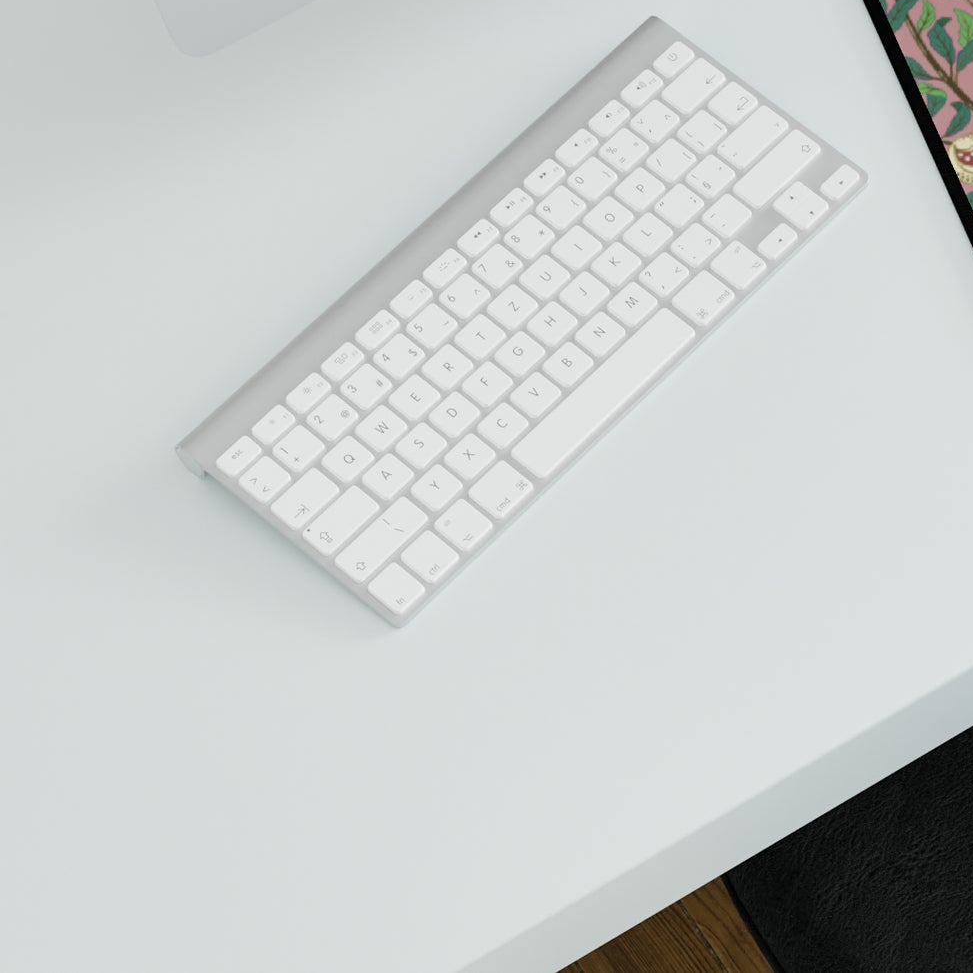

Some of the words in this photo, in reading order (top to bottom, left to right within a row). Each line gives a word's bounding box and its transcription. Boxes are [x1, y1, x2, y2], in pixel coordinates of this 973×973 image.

[574, 176, 585, 185] 0
[635, 183, 645, 194] P
[542, 205, 552, 214] 9
[604, 212, 616, 223] O
[510, 234, 521, 244] 8
[640, 229, 653, 238] L
[607, 255, 622, 267] K
[477, 263, 487, 273] 7
[538, 270, 553, 282] U
[578, 286, 588, 297] J
[446, 293, 457, 303] 6
[624, 296, 640, 309] M
[507, 300, 521, 313] Z
[543, 315, 557, 328] H
[413, 323, 424, 333] 5
[592, 326, 607, 339] N
[474, 330, 486, 341] T
[407, 348, 418, 358] $
[512, 346, 524, 357] G
[381, 353, 391, 362] 4
[560, 357, 573, 368] B
[441, 362, 455, 372] R
[479, 376, 489, 387] F
[346, 384, 358, 394] 3
[527, 387, 540, 397] V
[409, 391, 422, 403] E
[445, 407, 458, 419] D
[313, 414, 325, 425] 2
[496, 418, 509, 429] C
[373, 420, 390, 435] W
[413, 438, 425, 449] S
[231, 448, 244, 460] esc
[343, 453, 356, 465] Q
[461, 448, 476, 461] X
[380, 470, 393, 481] A
[428, 479, 440, 490] Y
[495, 496, 511, 512] cmd
